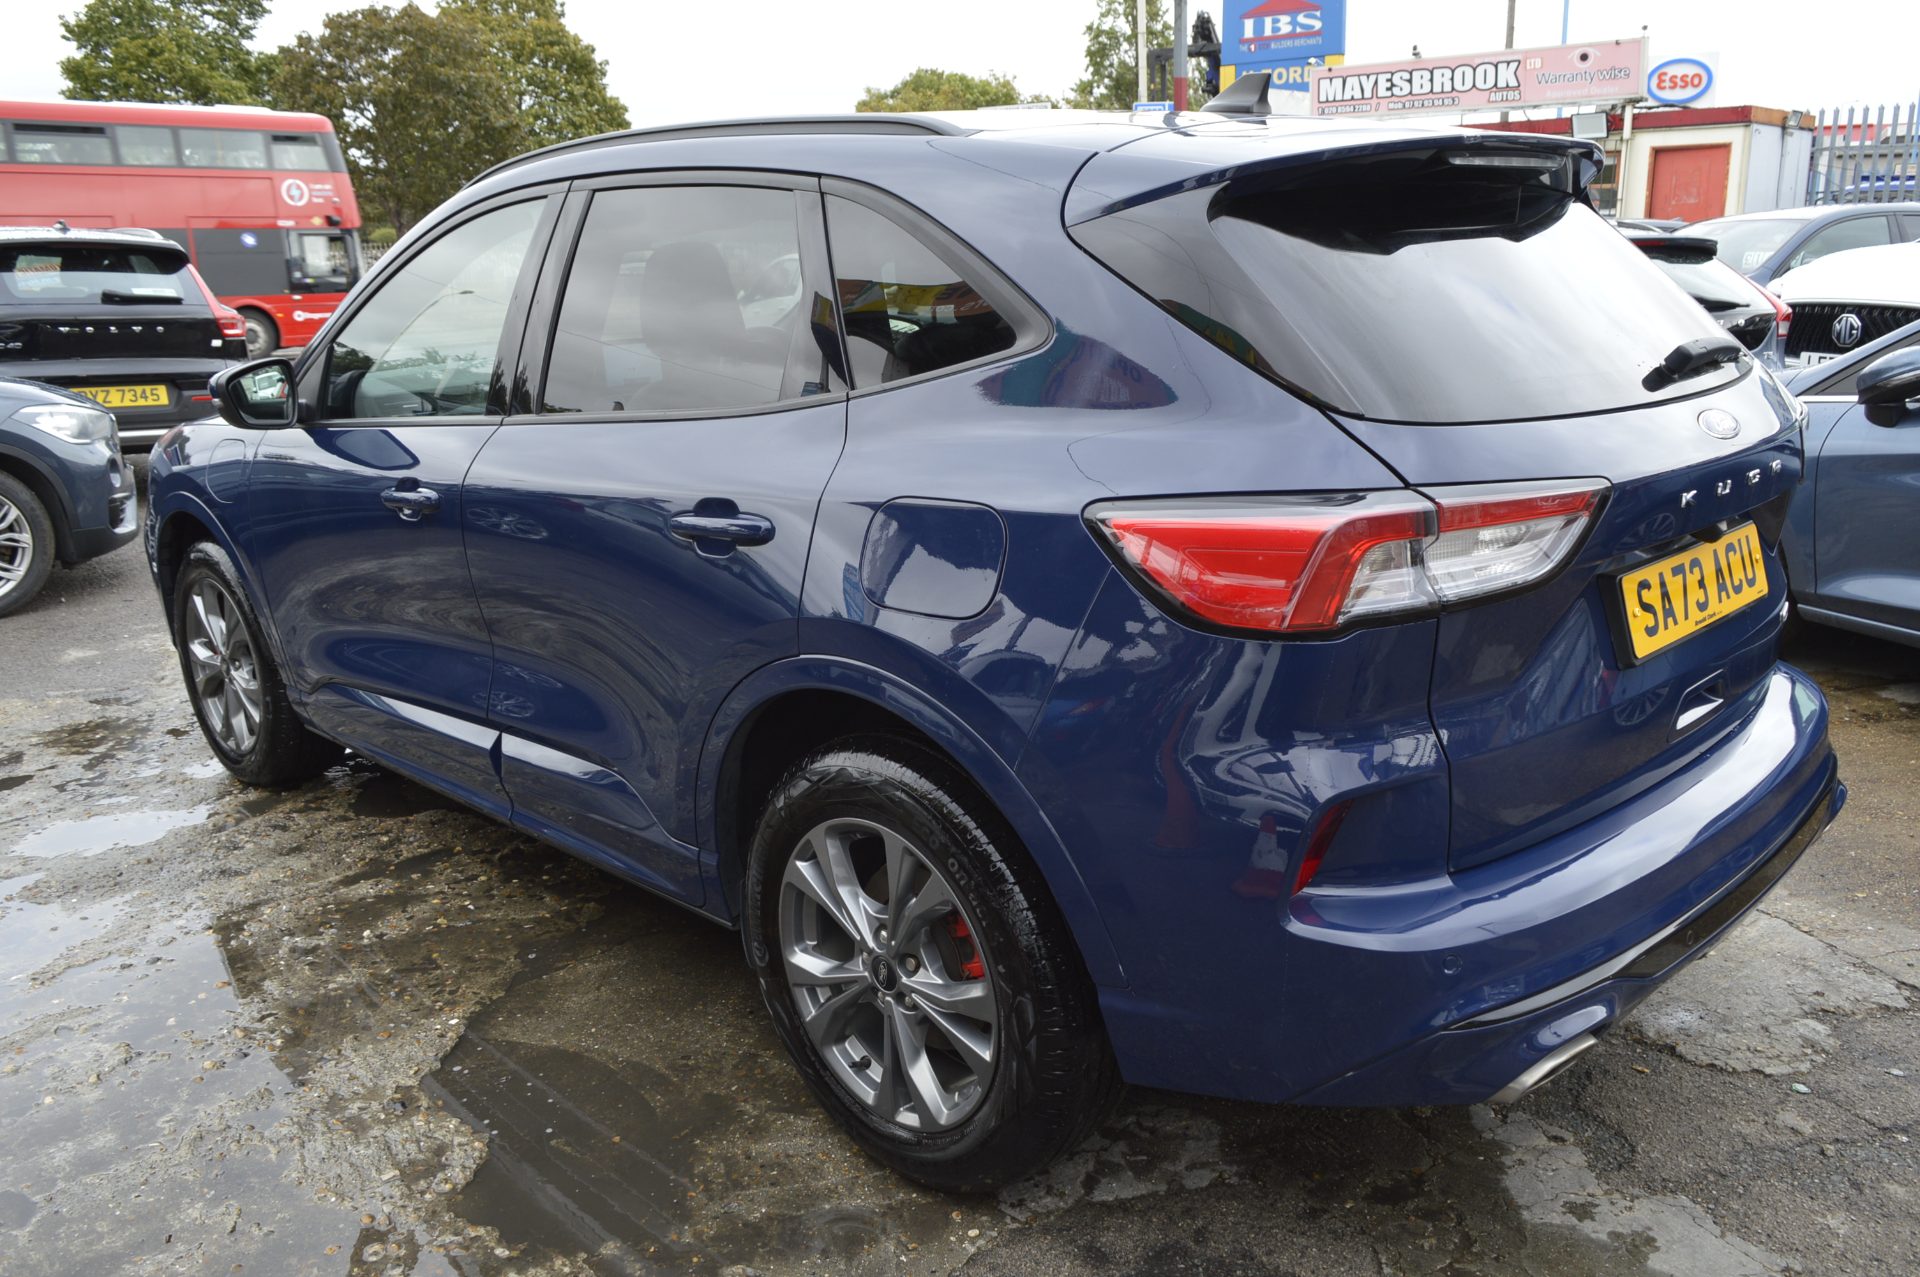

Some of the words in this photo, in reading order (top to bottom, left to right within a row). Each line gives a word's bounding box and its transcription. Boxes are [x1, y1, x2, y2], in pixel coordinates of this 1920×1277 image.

[1243, 10, 1323, 38] IBS
[1318, 60, 1520, 103] MAYESBROOK
[1526, 58, 1542, 70] LTD
[1536, 69, 1596, 85] Warranty
[1597, 66, 1631, 80] wise
[1489, 90, 1521, 103] AUTOS
[1834, 317, 1858, 343] MG
[116, 388, 161, 404] 7345
[1680, 459, 1782, 508] KUGA
[1636, 556, 1710, 638] SA73
[1714, 535, 1757, 605] ACU
